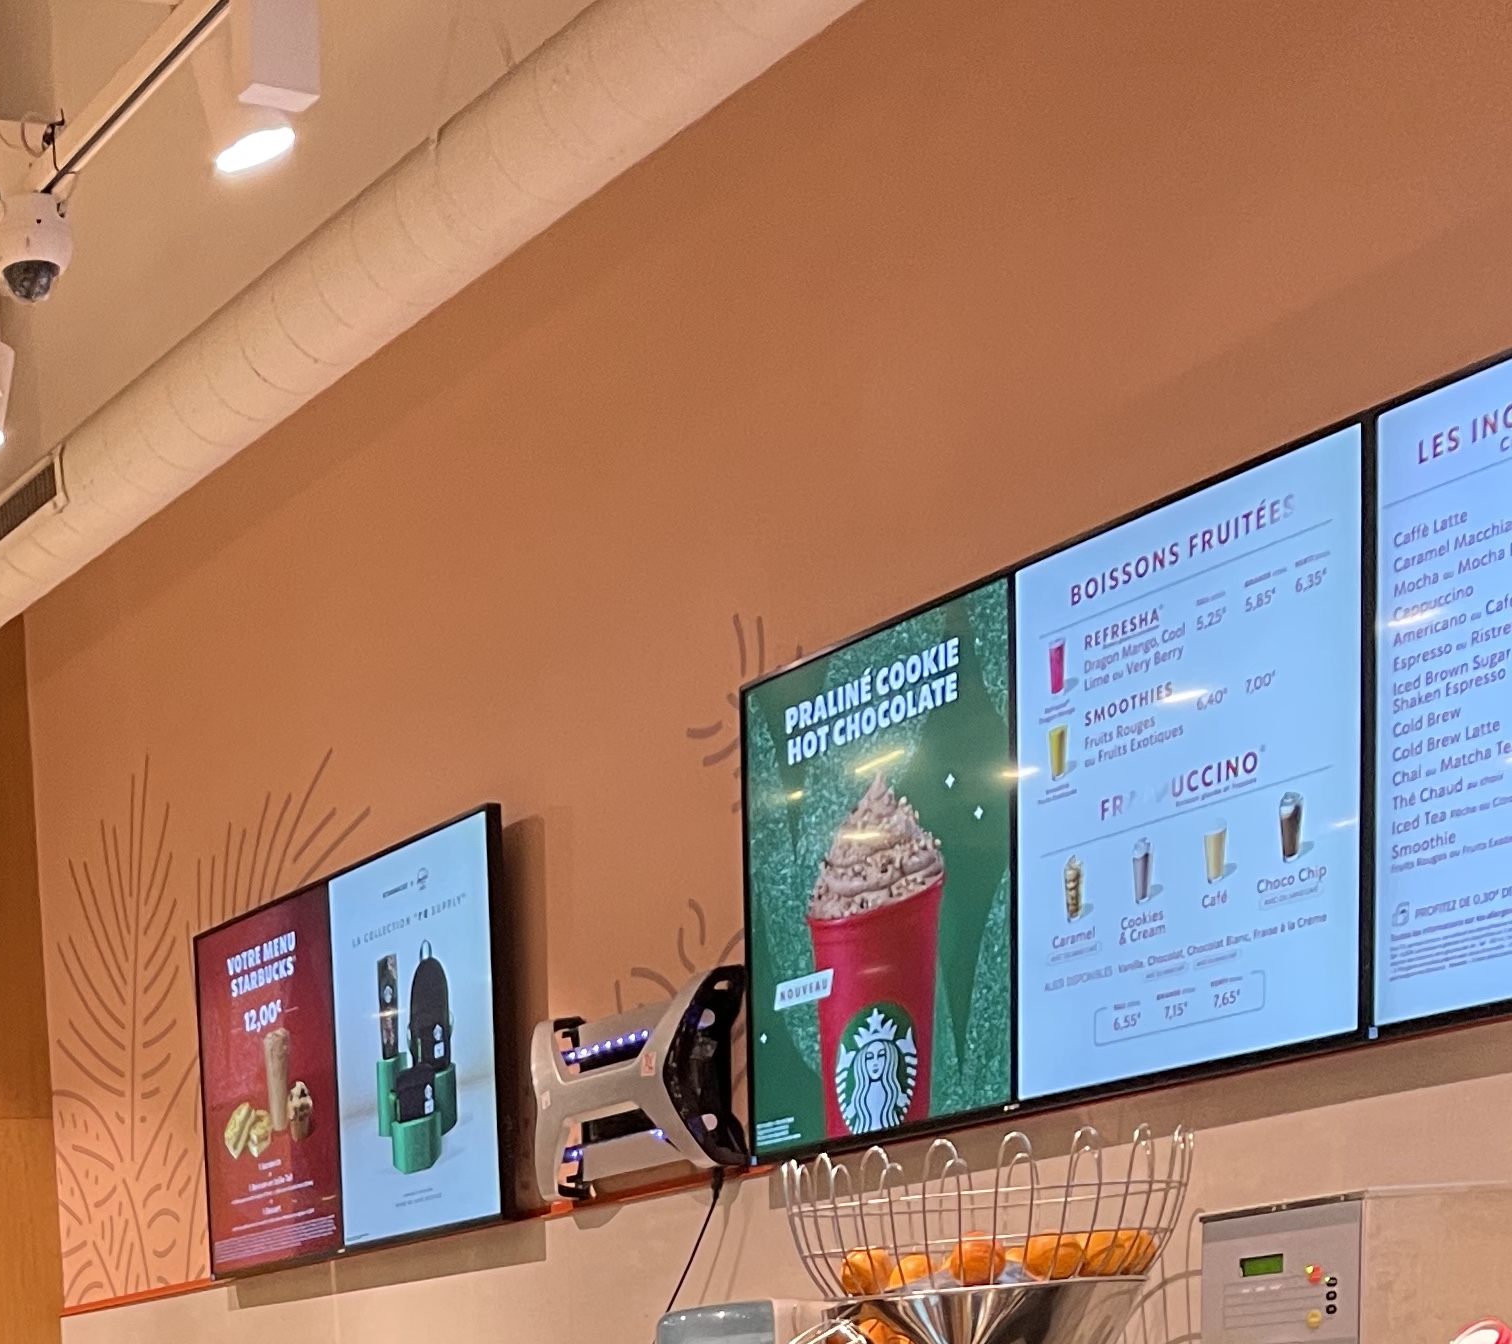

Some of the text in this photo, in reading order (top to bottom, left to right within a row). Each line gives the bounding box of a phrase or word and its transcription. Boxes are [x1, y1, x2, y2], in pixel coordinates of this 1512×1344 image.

[1417, 425, 1461, 465] LES
[1393, 511, 1468, 548] Caffè Latte
[1070, 494, 1295, 606] BOISSONS FRUITÉES
[1393, 539, 1450, 573] Caramel
[1393, 572, 1439, 598] Mocha
[1457, 548, 1506, 575] Mocha
[1393, 585, 1474, 622] Cappuccino
[1162, 622, 1186, 645] Cool
[1392, 612, 1467, 647] Americano
[1083, 673, 1110, 692] Lime
[1125, 656, 1152, 677] Very
[1154, 645, 1185, 667] Berry
[1393, 643, 1453, 673] Espresso
[1393, 648, 1512, 697] Iced Brown Sugar
[784, 636, 960, 735] PRALINÉ COOKIE
[1392, 667, 1506, 715] Shaken Espresso
[787, 671, 959, 766] HOT CHOCOLATE
[1083, 681, 1174, 728] SMOOTHIES
[1392, 707, 1462, 738] Cold Brew
[1083, 715, 1157, 752] Fruits Rouges
[1097, 742, 1128, 764] Fruits
[1129, 724, 1185, 753] Exotiques
[1391, 720, 1501, 762] Cold Brew Latte
[1440, 748, 1493, 773] Matcha
[1392, 791, 1416, 811] Thé
[1419, 776, 1464, 803] Chaud
[1391, 813, 1421, 836] Iced
[1424, 810, 1448, 826] Tea
[1391, 831, 1457, 861] Smoothie
[1256, 864, 1328, 895] Choco Chip
[1201, 889, 1229, 910] Café
[1051, 925, 1097, 950] Caramel
[1118, 922, 1167, 946] & Cream
[1120, 910, 1165, 931] Cookies
[226, 931, 296, 976] VOTRE MENU
[779, 977, 829, 1002] NOUVEAU
